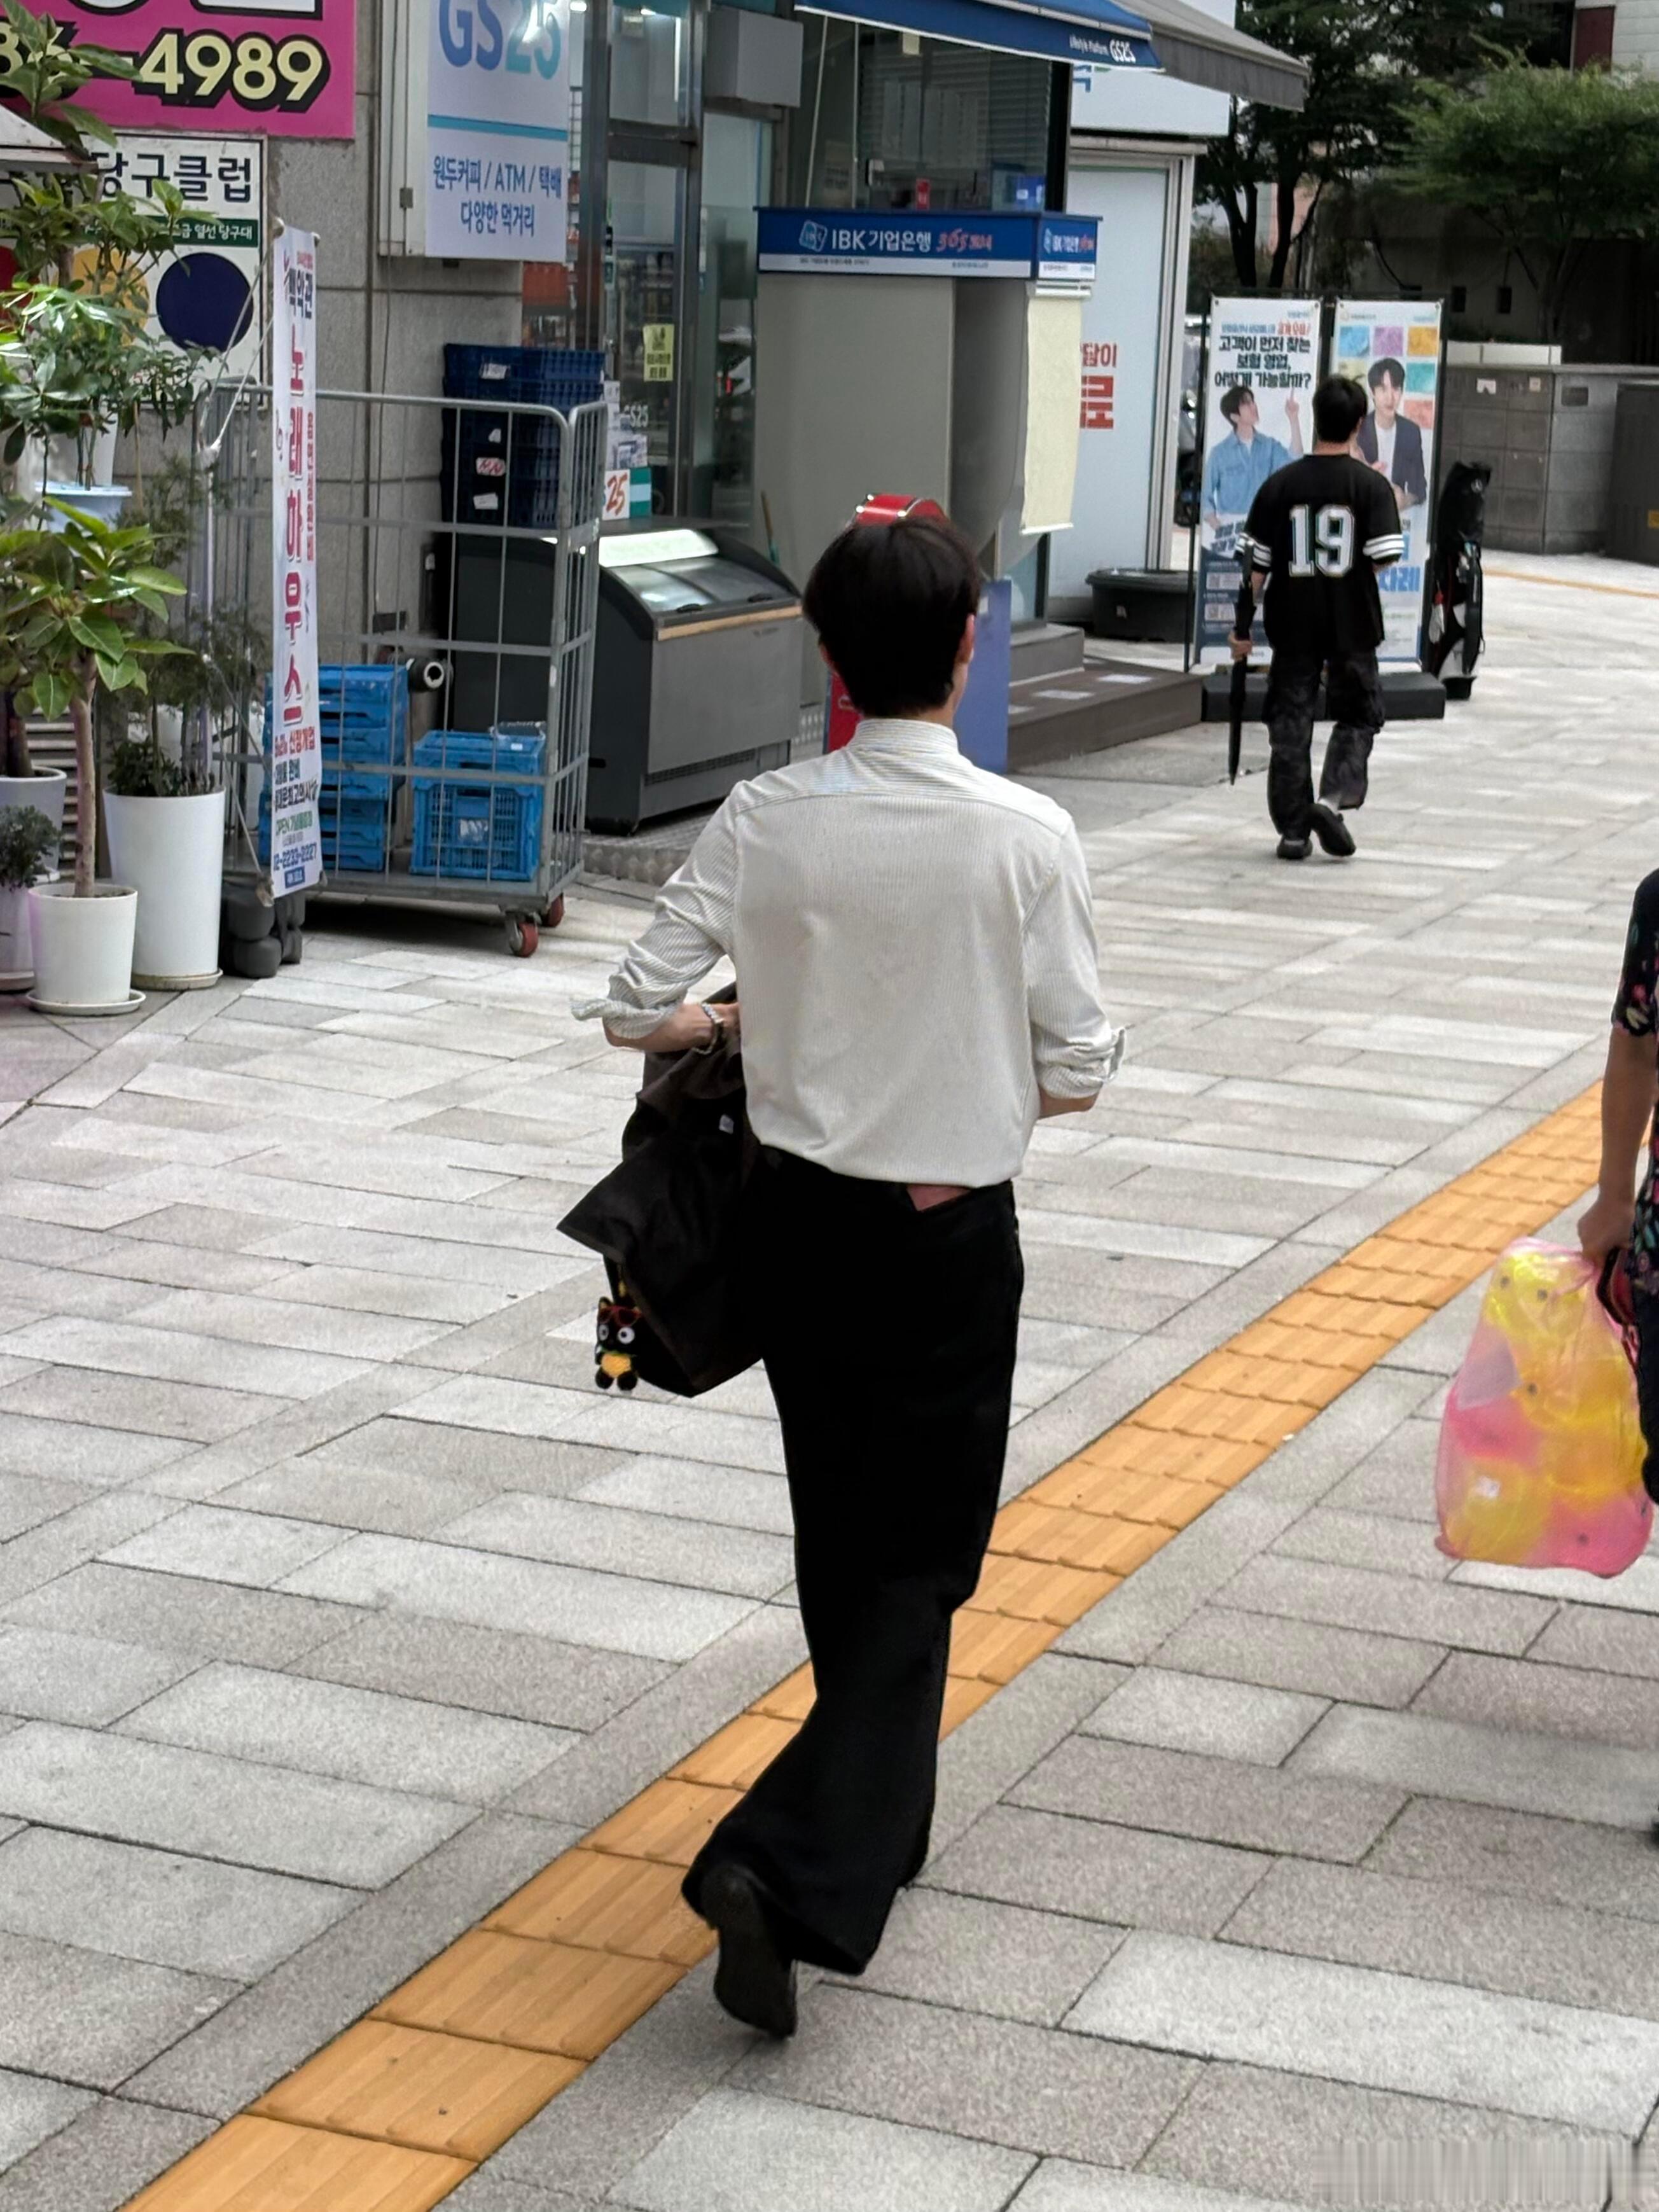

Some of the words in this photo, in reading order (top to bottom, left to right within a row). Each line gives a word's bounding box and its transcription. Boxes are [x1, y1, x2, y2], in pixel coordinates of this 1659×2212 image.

[439, 0, 561, 80] GS25
[1109, 39, 1136, 63] GS25
[91, 152, 251, 203] 당구클럽
[433, 155, 482, 193] 원두커피
[495, 162, 526, 193] ATM
[539, 165, 562, 200] 택배
[219, 224, 253, 240] 당구대
[461, 200, 498, 234] 다양한
[501, 202, 534, 237] 먹거리
[832, 229, 866, 251] IBK
[868, 229, 931, 253] 기업은행
[1219, 335, 1256, 351] 고객이
[1260, 336, 1284, 352] 먼저
[1287, 337, 1310, 353] 찾는
[1237, 354, 1261, 369] 보험
[1288, 504, 1355, 577] 19
